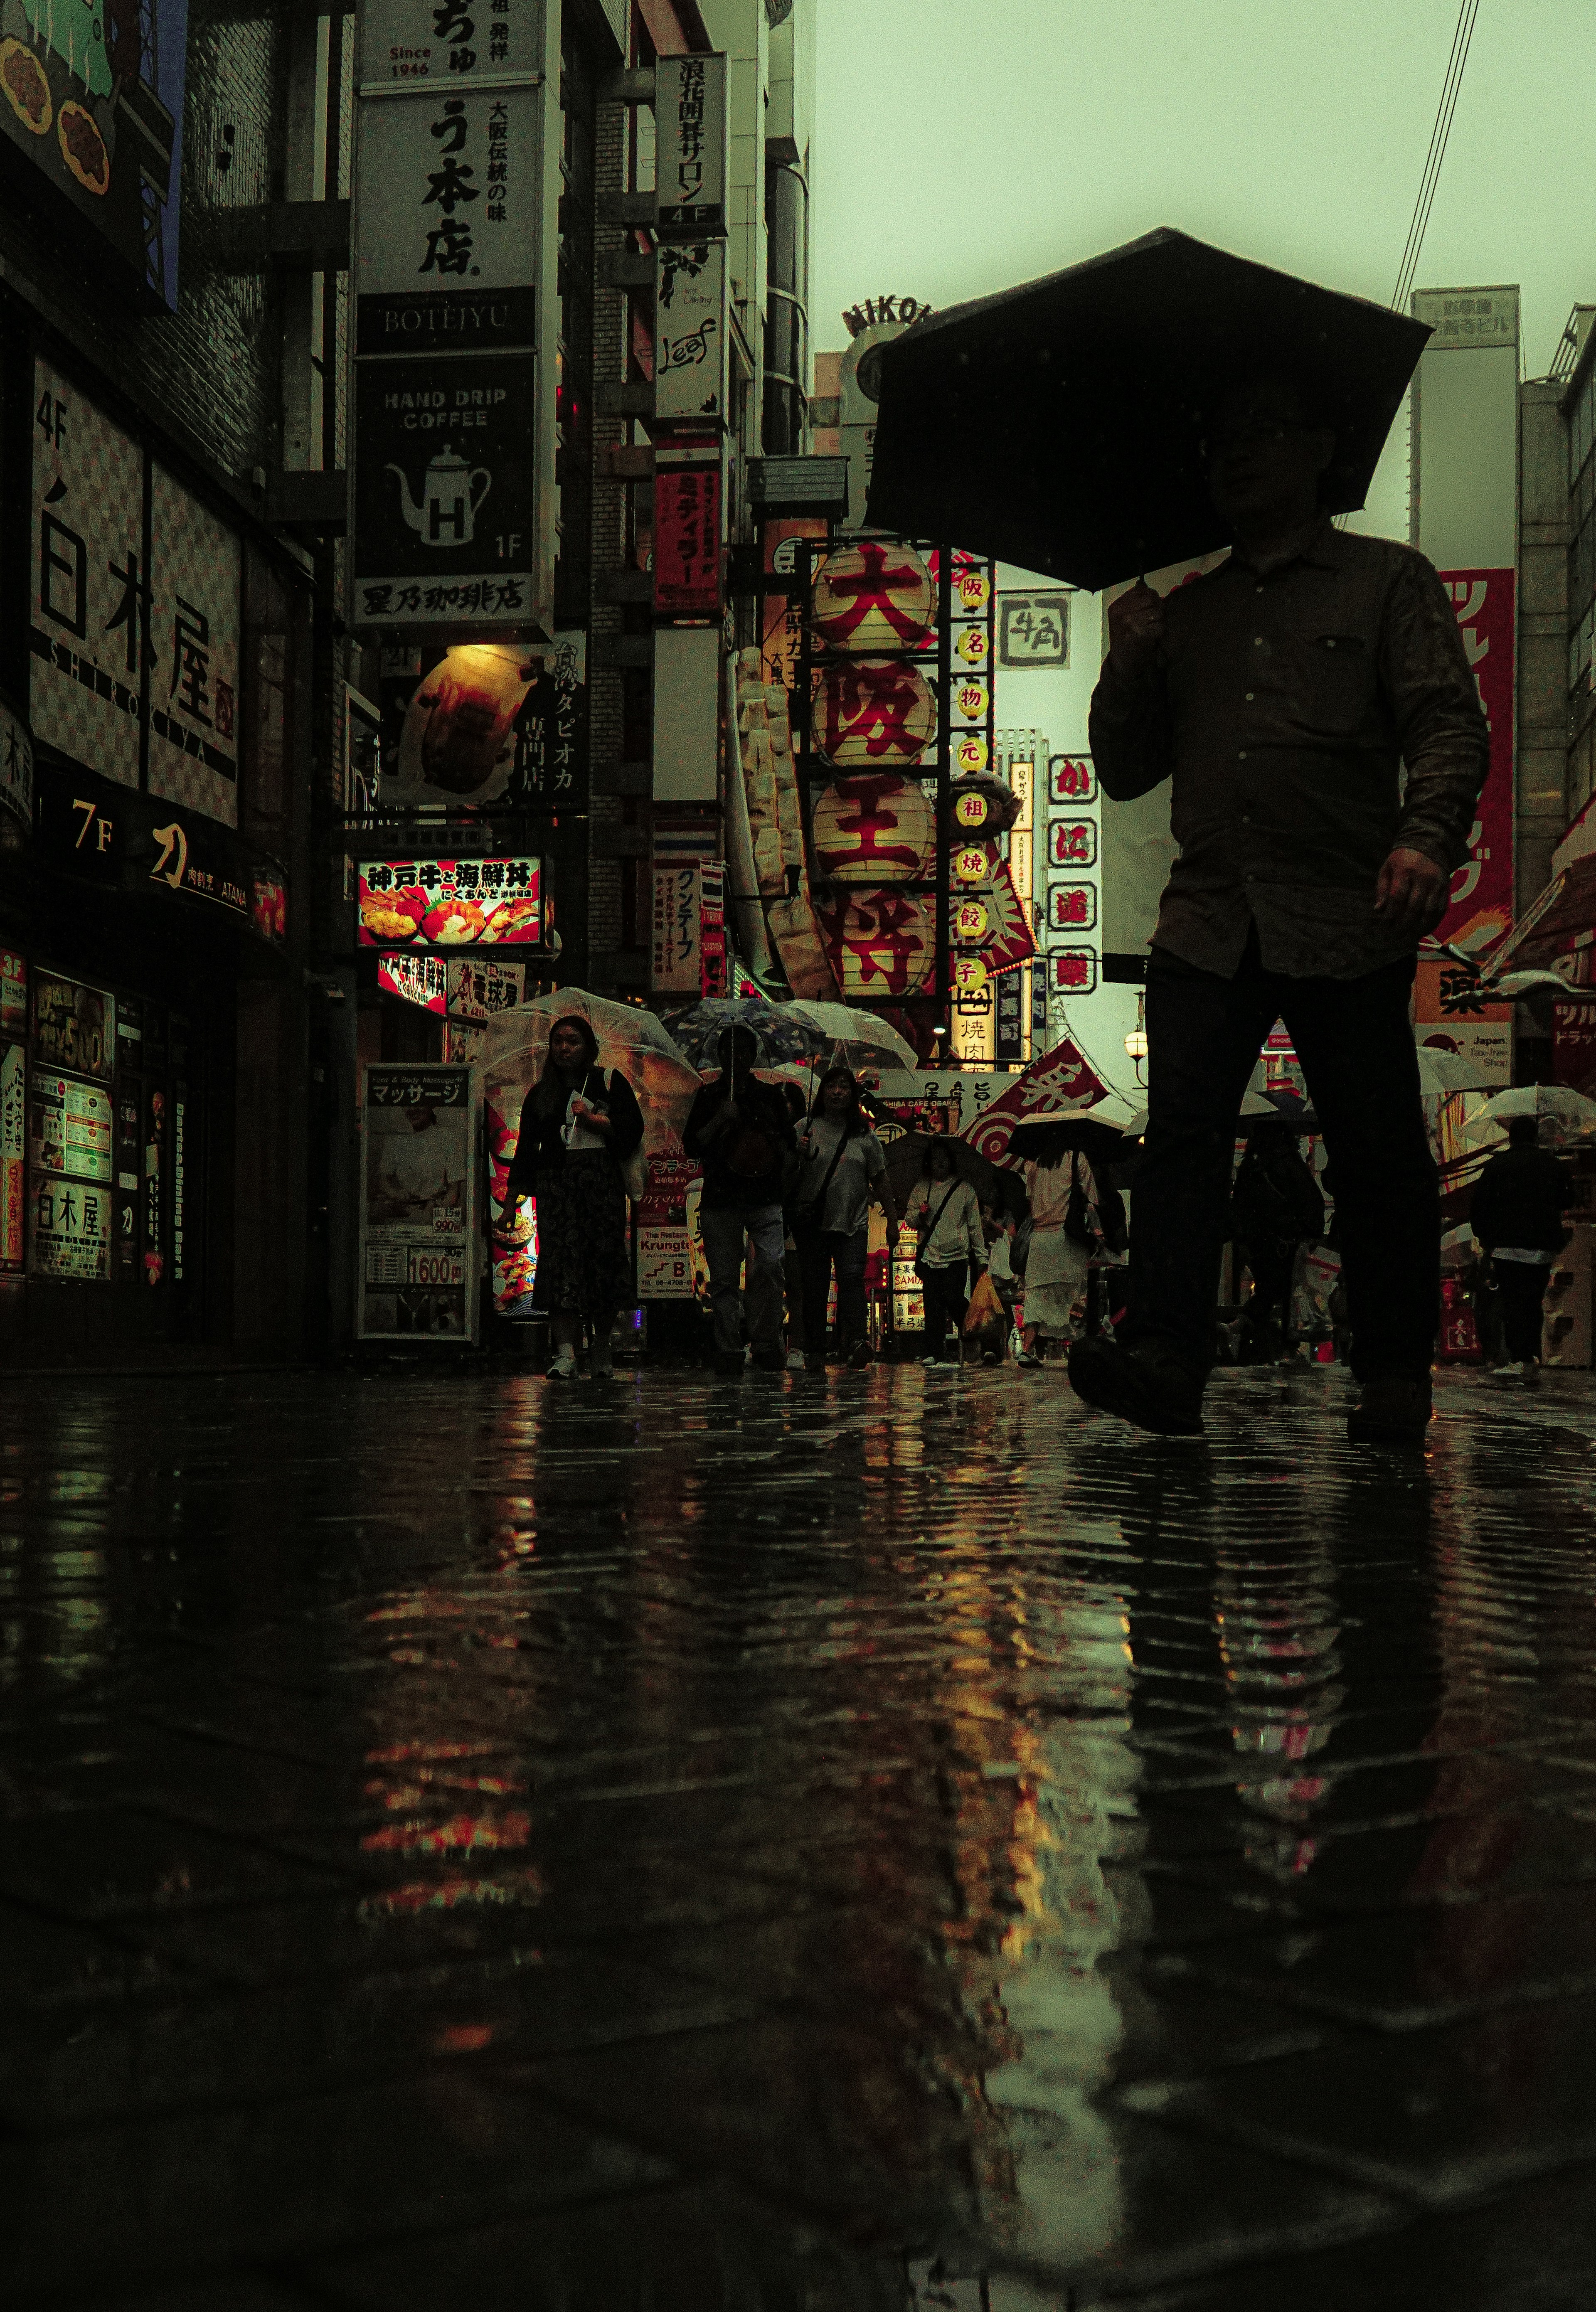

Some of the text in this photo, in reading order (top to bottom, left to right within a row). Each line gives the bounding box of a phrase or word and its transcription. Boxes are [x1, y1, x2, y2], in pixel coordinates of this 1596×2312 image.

[390, 47, 431, 61] Since
[392, 62, 429, 77] 1946
[487, 101, 509, 223] 大阪伝統の味
[385, 388, 507, 409] HAND DRIP
[36, 389, 67, 451] 4F
[404, 410, 488, 429] COFFEE
[495, 534, 522, 558] 1F
[362, 579, 525, 615] 星乃珈琲店
[368, 862, 531, 890] 神戸牛と海鮮丼
[372, 1084, 461, 1104] マッサージ
